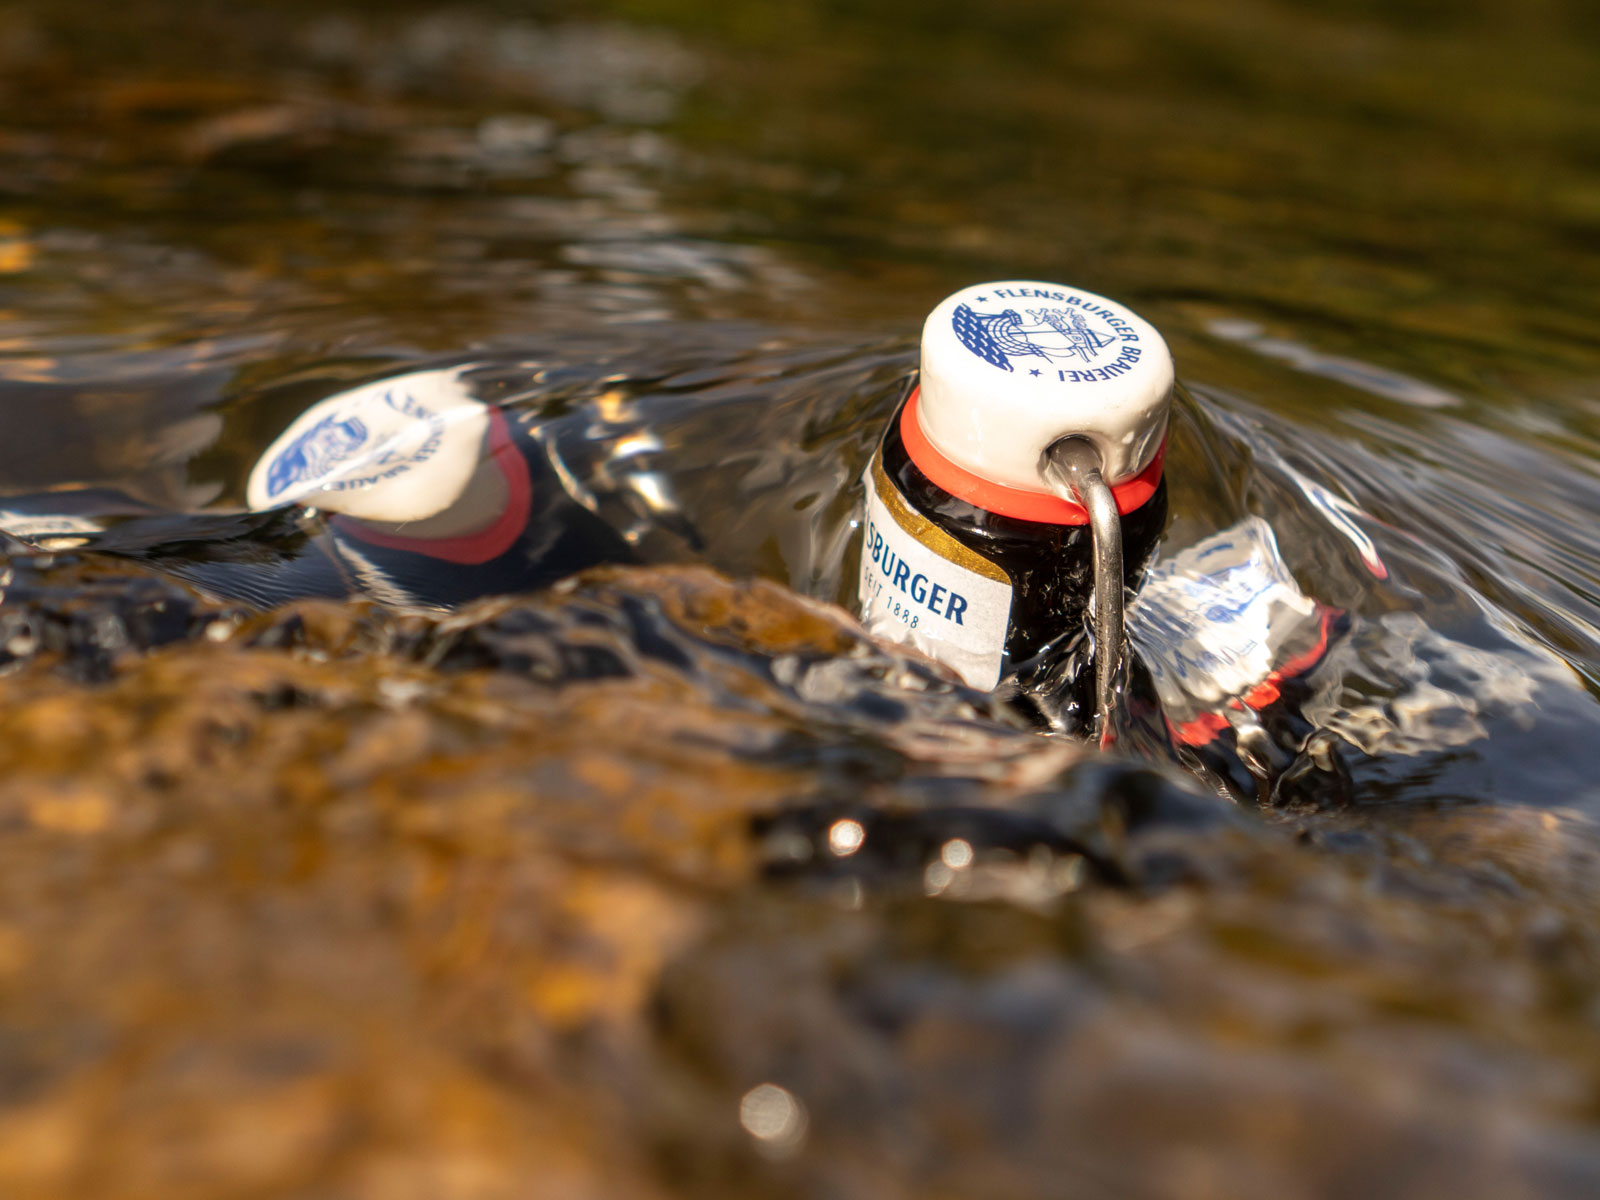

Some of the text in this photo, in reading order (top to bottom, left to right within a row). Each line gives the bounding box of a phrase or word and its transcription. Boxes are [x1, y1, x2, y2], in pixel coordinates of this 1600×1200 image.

[993, 288, 1142, 383] FLENSBURGER BRAUEREI
[866, 514, 968, 626] SBURGER
[886, 595, 920, 629] 1888
